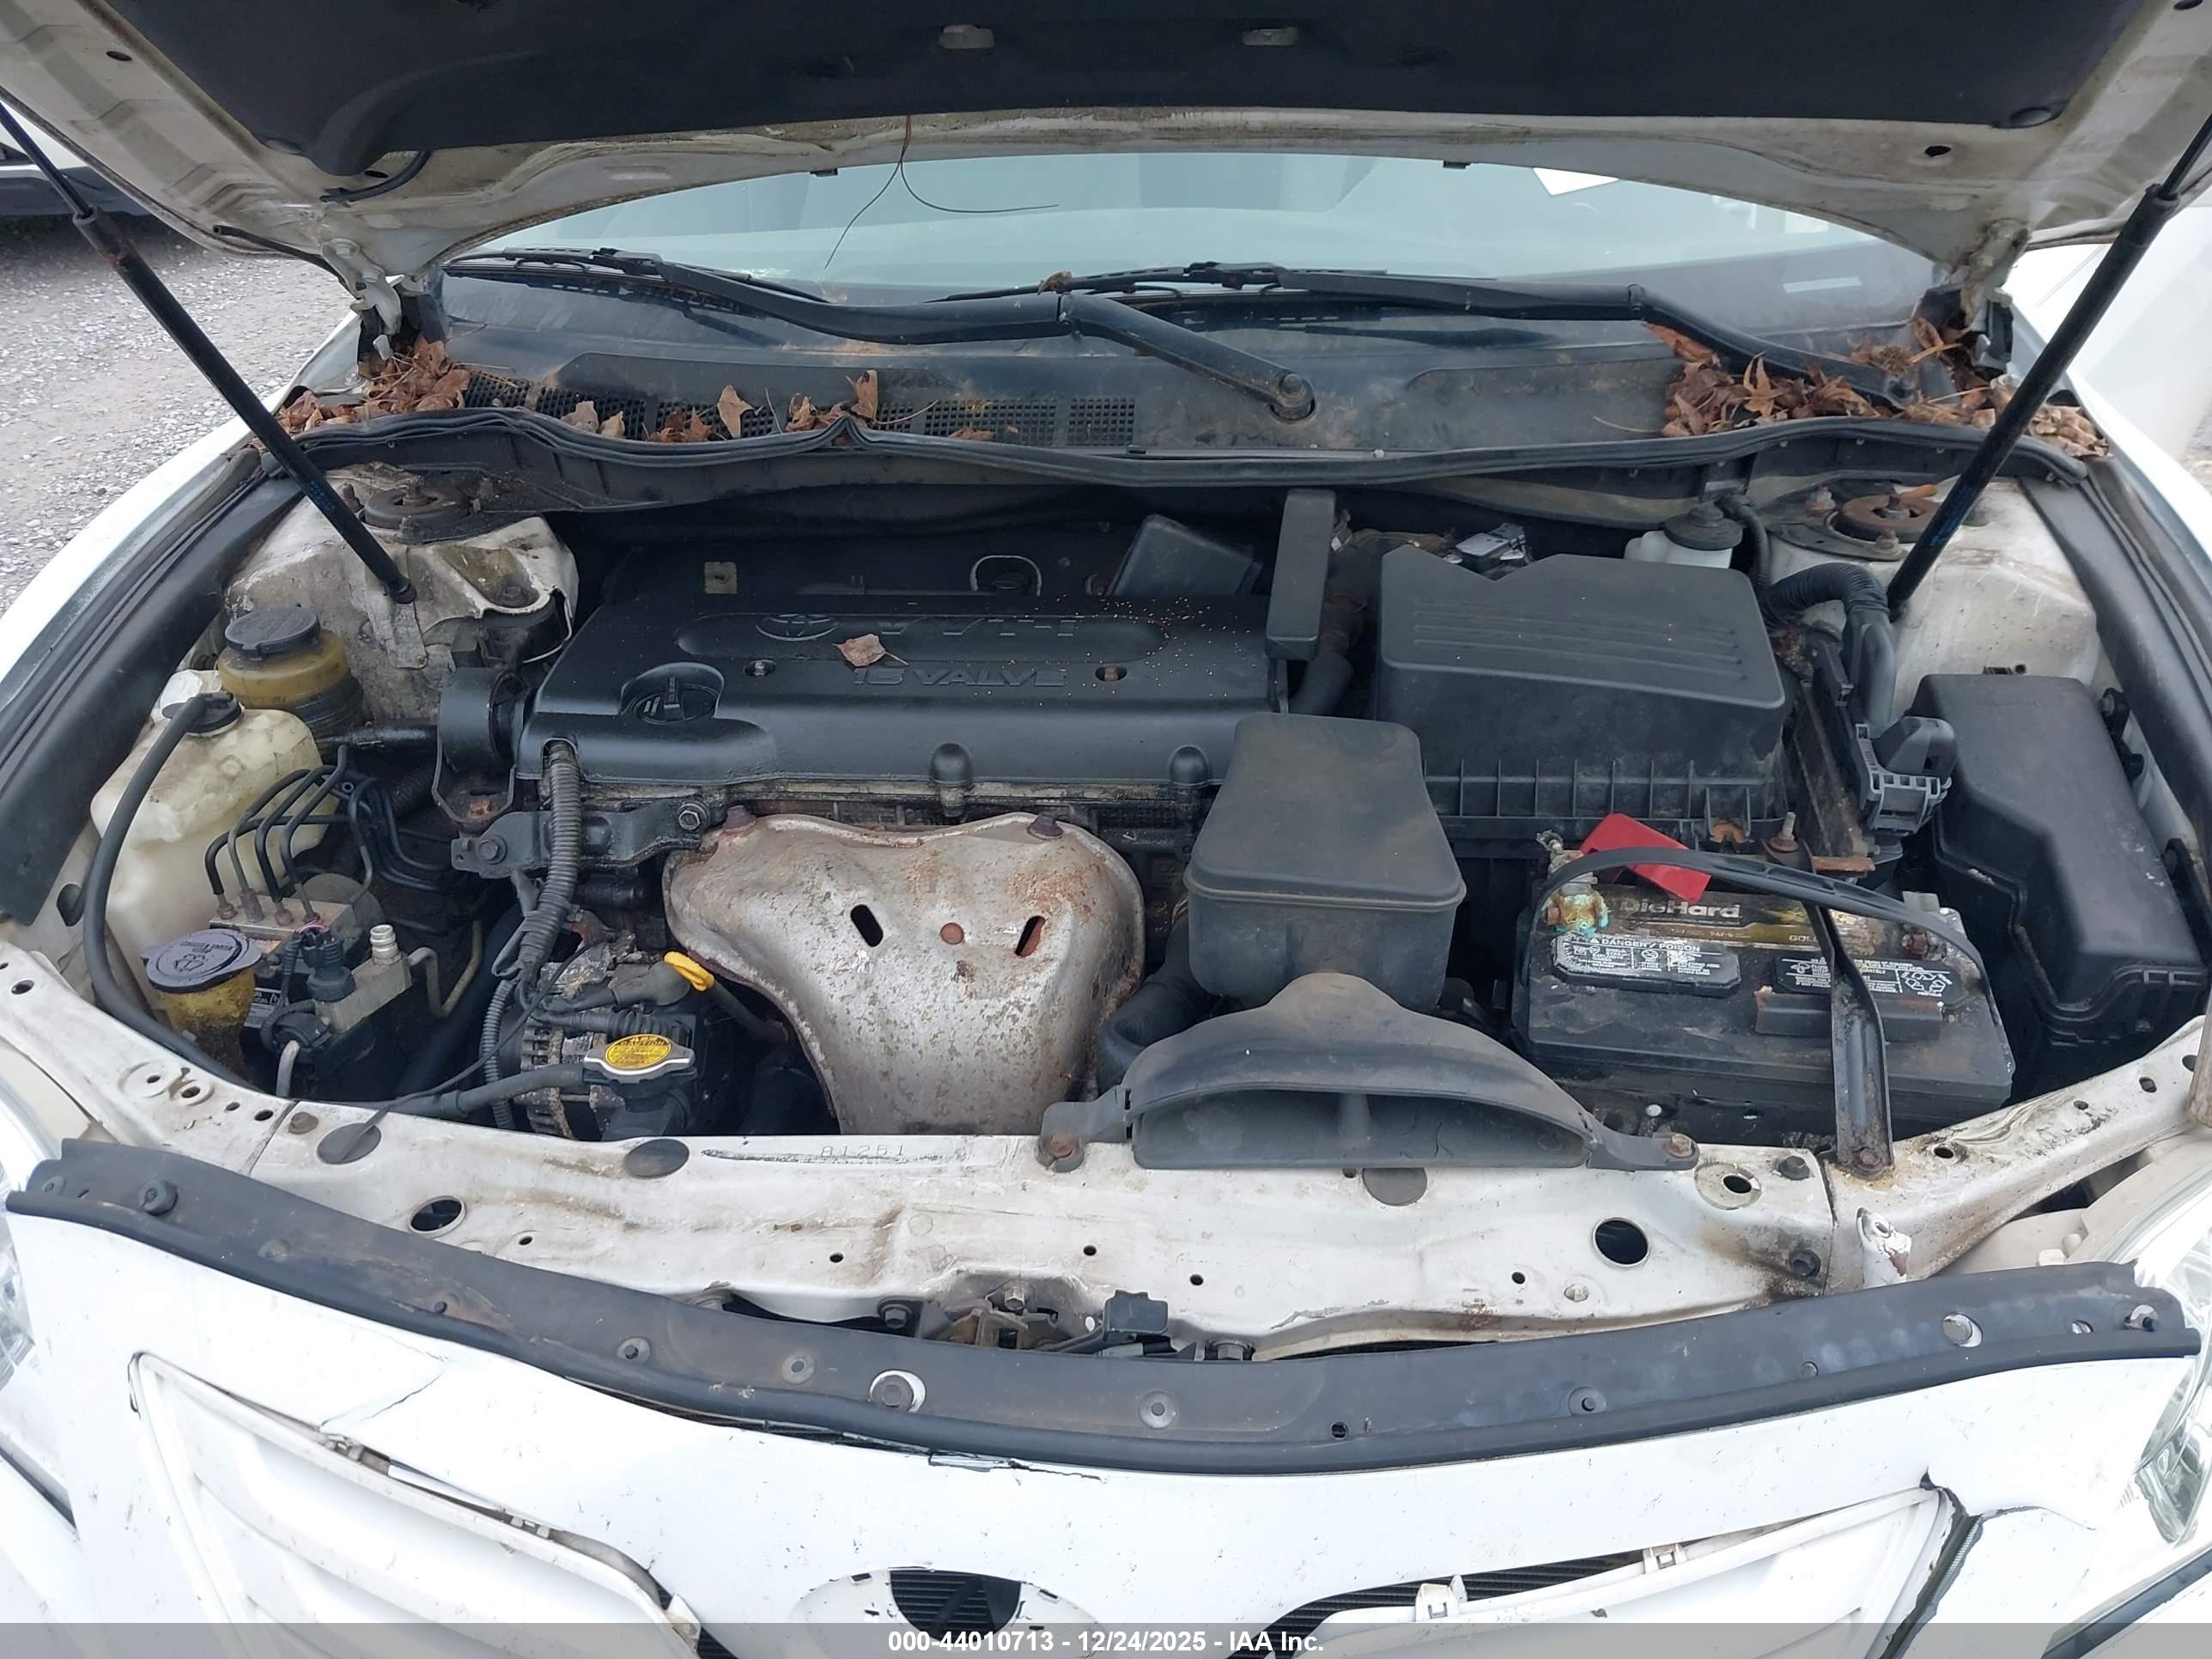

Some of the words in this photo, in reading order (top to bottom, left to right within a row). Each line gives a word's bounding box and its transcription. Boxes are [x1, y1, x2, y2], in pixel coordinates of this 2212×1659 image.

[913, 667, 1068, 686] VALVE
[1620, 898, 1743, 919] DieHard
[1601, 939, 1649, 949] DANGER
[1658, 943, 1701, 952] POISON
